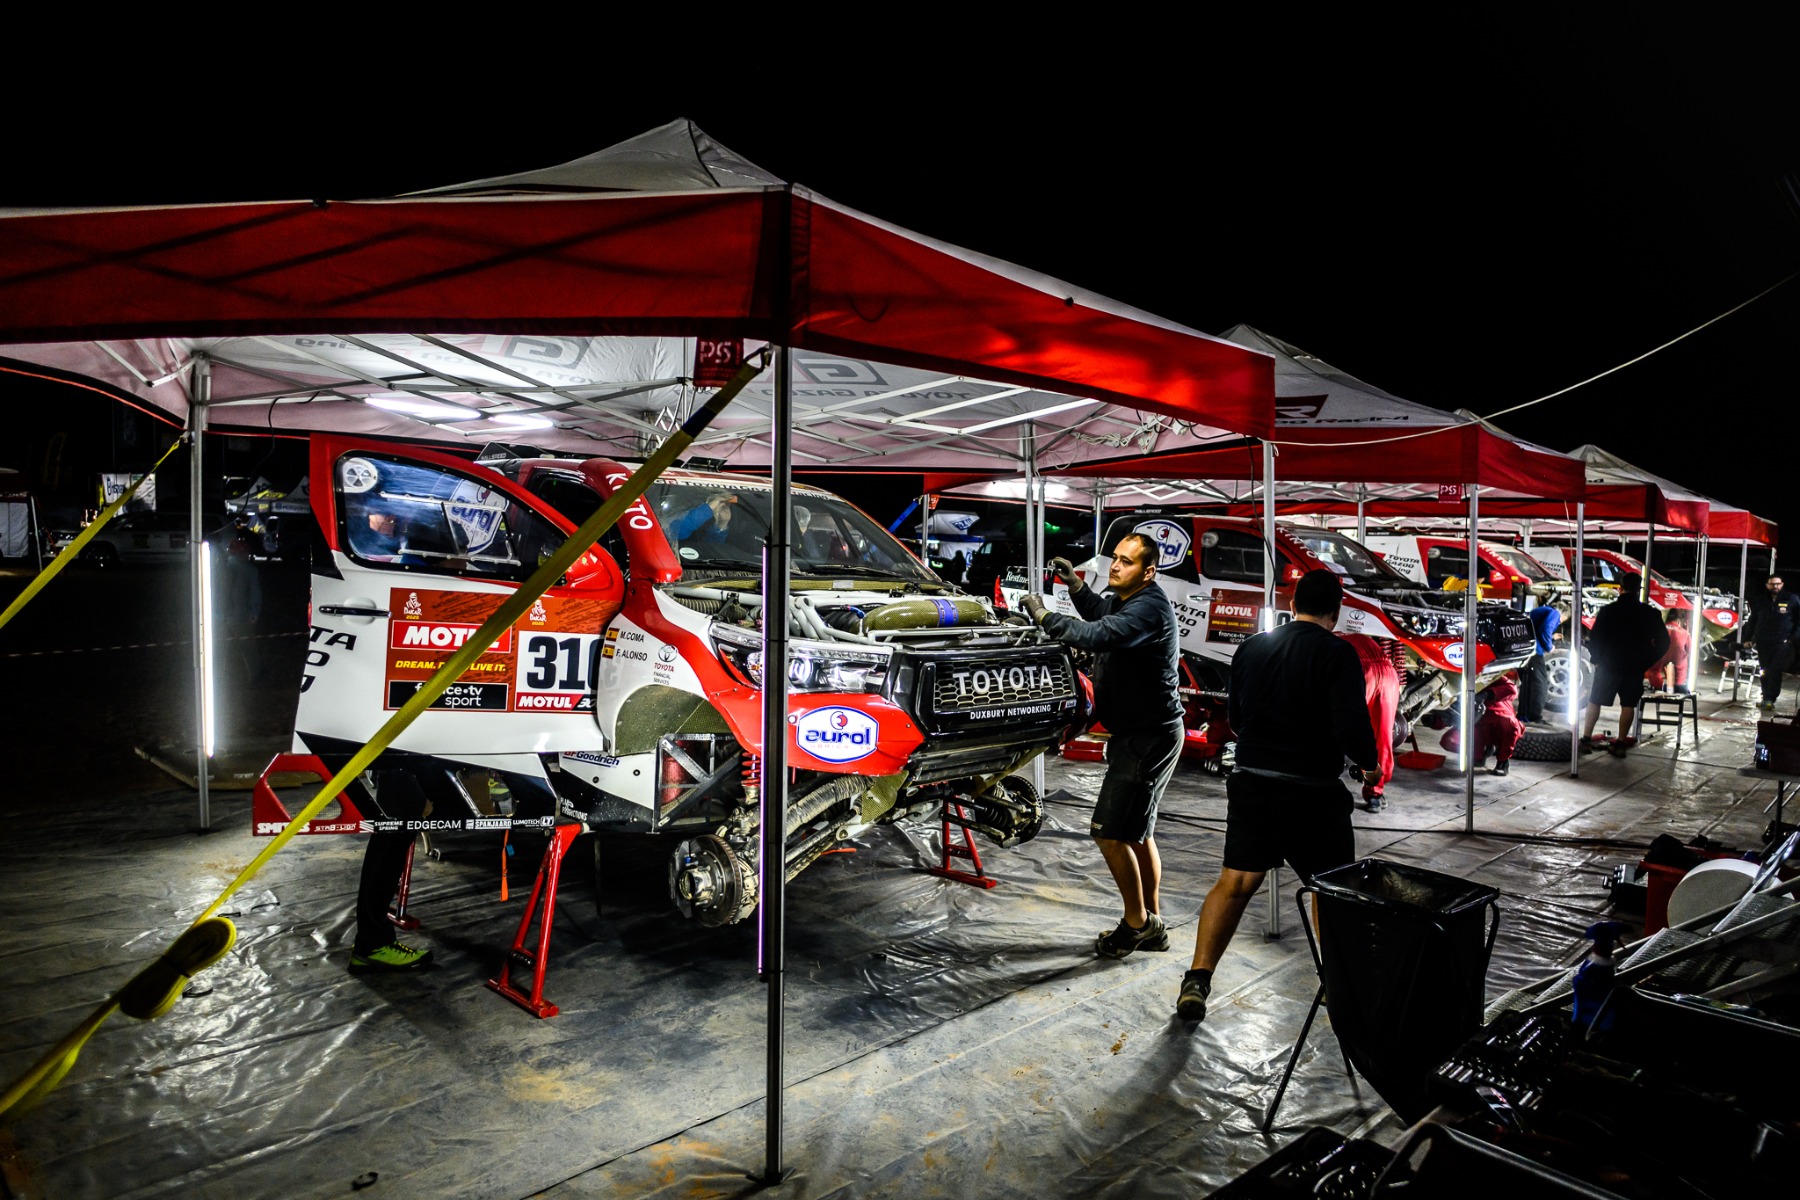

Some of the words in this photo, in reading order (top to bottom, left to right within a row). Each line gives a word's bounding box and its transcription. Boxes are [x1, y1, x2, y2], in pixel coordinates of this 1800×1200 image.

[605, 473, 653, 530] KTO
[1156, 541, 1182, 557] rol
[1388, 554, 1420, 564] TOYOTA
[1171, 600, 1206, 619] YOTA
[1215, 605, 1252, 617] MOTUL
[402, 625, 500, 649] MOT
[1500, 624, 1529, 638] TOYOTA
[622, 649, 648, 662] ALONSO
[395, 660, 436, 669] DREAM.
[470, 663, 494, 672] LIVE
[654, 662, 675, 672] TOYOTA
[952, 665, 1054, 696] TOYOTA
[445, 696, 482, 709] sport
[518, 695, 573, 709] MOTUL
[970, 708, 1005, 720] DUXBURY
[1007, 704, 1052, 717] NETWORKING
[805, 727, 871, 745] eurol
[406, 820, 462, 830] EDGECAM
[475, 819, 512, 829] SPANJAARD
